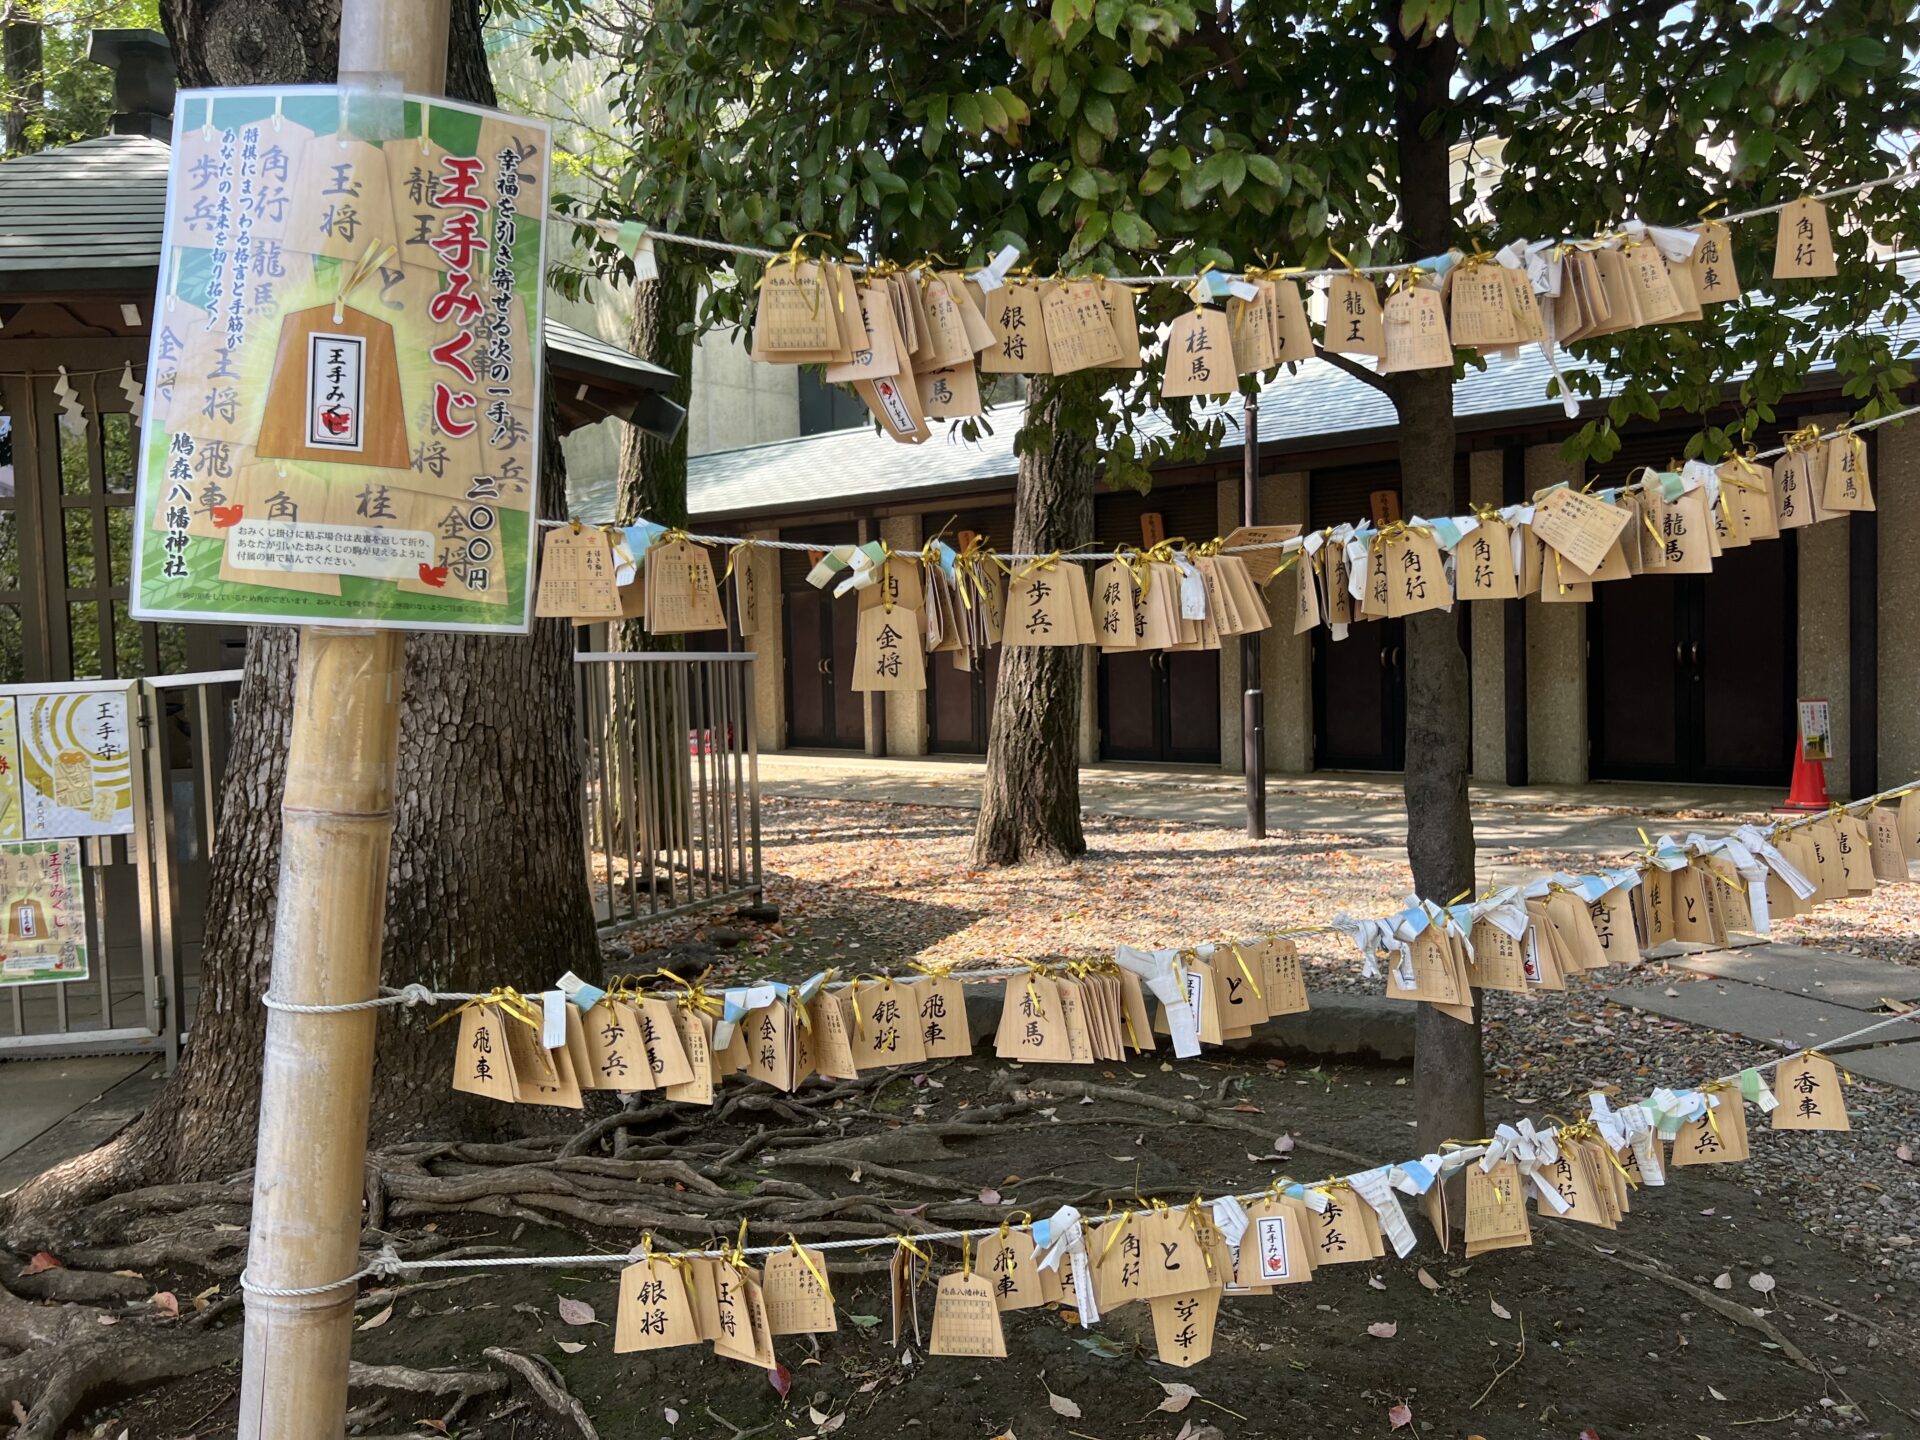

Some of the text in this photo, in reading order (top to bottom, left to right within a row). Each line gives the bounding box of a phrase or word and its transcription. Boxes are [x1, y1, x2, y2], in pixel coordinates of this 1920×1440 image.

[255, 143, 290, 224] 角行
[226, 127, 260, 350] 将棋にまつわる格言と手筋が
[1699, 239, 1722, 292] 飛車
[1794, 215, 1817, 267] 角行
[430, 156, 491, 438] 王手みくじ
[1342, 289, 1367, 343] 龍王
[1000, 305, 1029, 362] 銀将
[1185, 326, 1213, 383] 桂馬
[326, 348, 348, 437] 王手みくじ
[1779, 468, 1798, 519] 龍馬
[1841, 450, 1858, 500] 桂馬
[163, 433, 196, 578] 鳩森八幡神社
[236, 538, 426, 561] あなたが引いたおみくじの駒が見えるように
[236, 551, 359, 570] 付属の紐で結んでください。
[237, 525, 432, 550] おみくじ掛けに結ぶ場合は表裏を返して折り、
[465, 477, 499, 593] 二〇〇円
[1662, 512, 1688, 563] 龍馬
[1401, 548, 1428, 602] 角行
[1472, 536, 1494, 589] 角行
[1025, 580, 1053, 636] 歩兵
[1102, 581, 1121, 635] 銀将
[876, 623, 903, 678] 金将
[96, 702, 118, 761] 王手守
[48, 853, 65, 928] 王手みくじ
[1684, 895, 1698, 924] と
[1226, 977, 1244, 1005] と
[759, 1014, 778, 1073] 金将
[871, 999, 902, 1052] 銀将
[920, 993, 947, 1047] 飛車
[1019, 991, 1046, 1048] 龍馬
[472, 1026, 494, 1084] 飛車
[601, 1022, 629, 1078] 歩兵
[1793, 1071, 1821, 1120] 香車
[1554, 1155, 1578, 1209] 角行
[1318, 1203, 1347, 1254] 歩兵
[993, 1247, 1018, 1300] 飛車
[1120, 1233, 1140, 1289] 角行
[1160, 1242, 1180, 1271] と
[637, 1281, 669, 1336] 銀将
[718, 1282, 738, 1338] 玉将
[941, 1287, 988, 1299] 鳩森八幡神社
[1173, 1298, 1200, 1351] 歩兵
